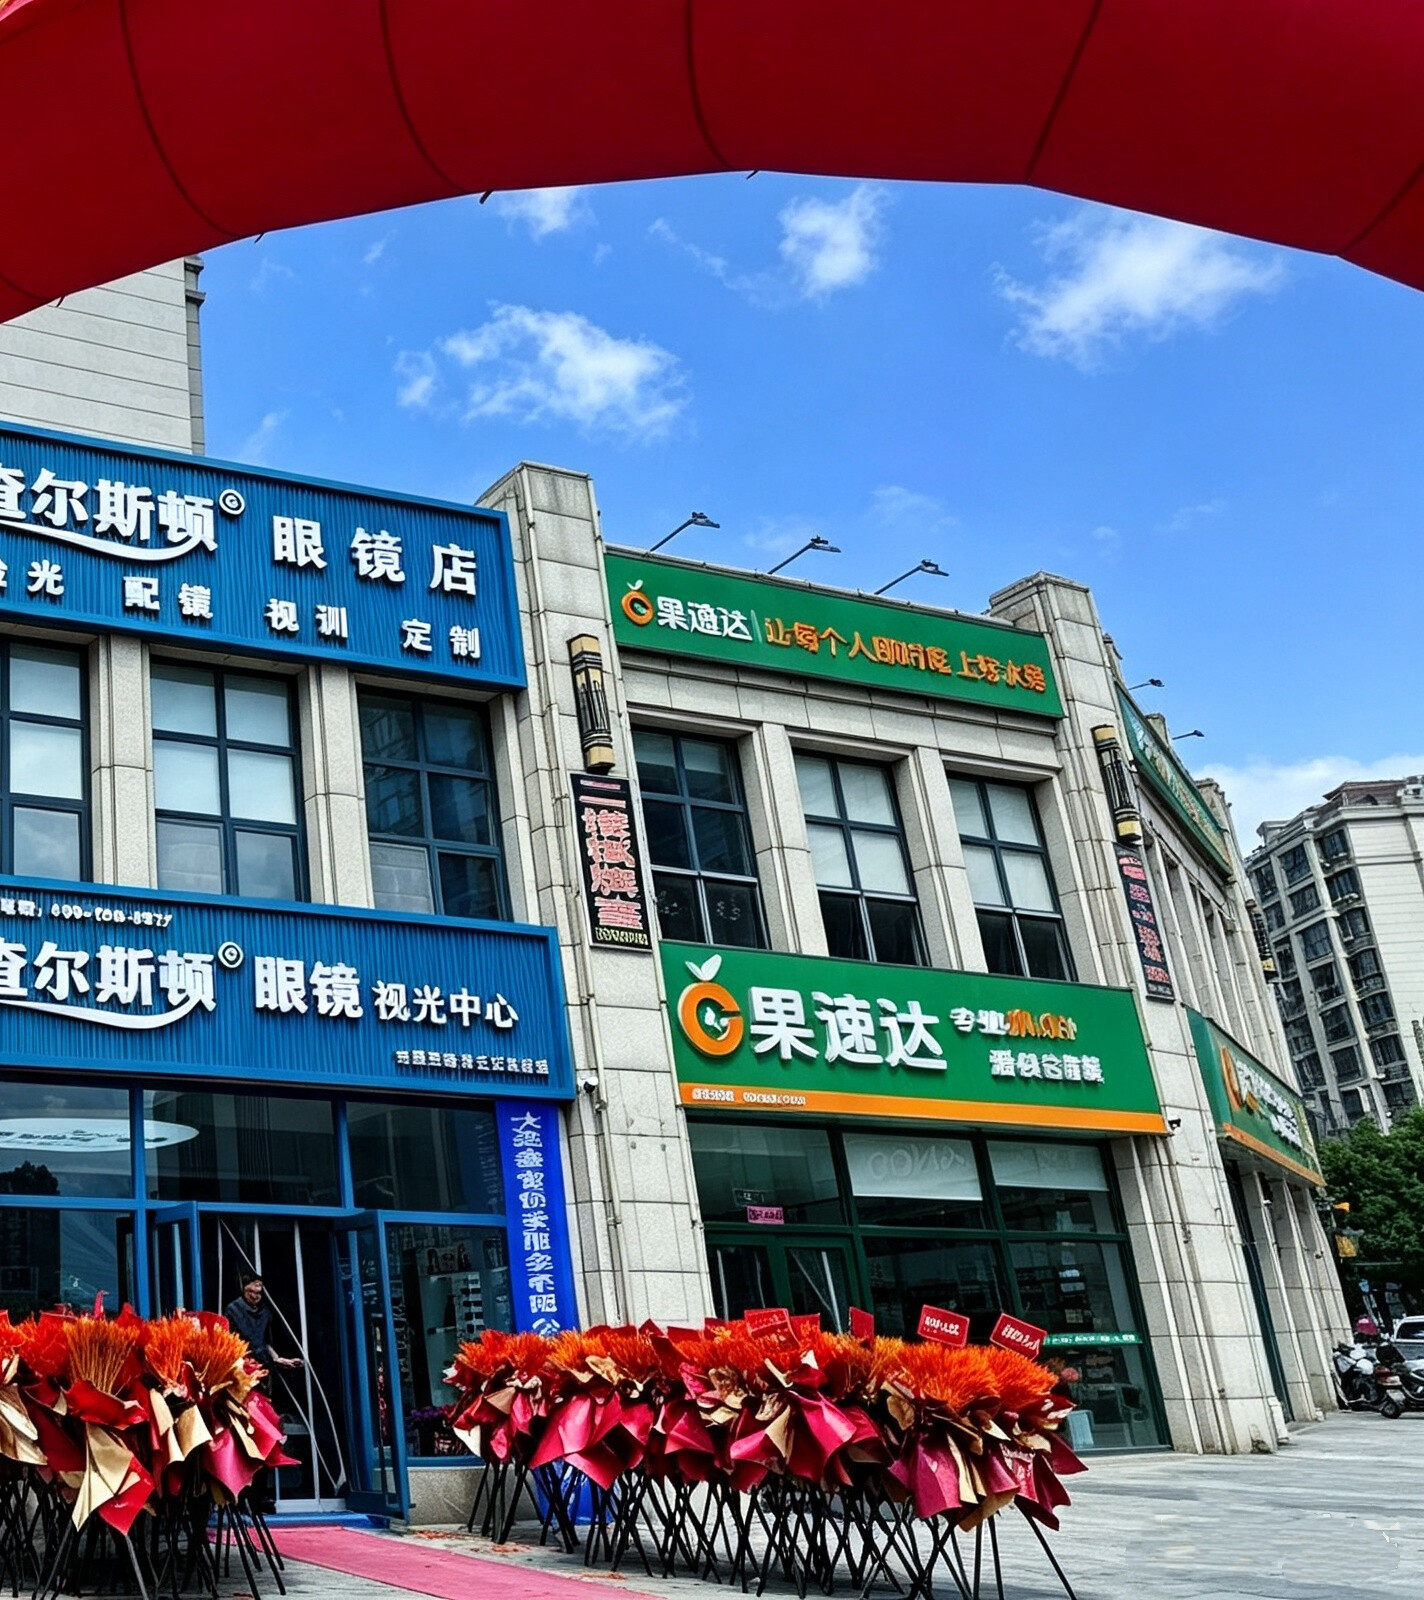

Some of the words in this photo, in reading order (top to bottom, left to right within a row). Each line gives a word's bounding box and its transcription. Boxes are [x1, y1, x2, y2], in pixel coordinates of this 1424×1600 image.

[272, 515, 479, 596] 眼镜店
[264, 597, 348, 640] 视训
[400, 618, 481, 660] 定制
[254, 957, 363, 1020] 眼镜
[371, 980, 519, 1028] 视光中心
[749, 985, 948, 1071] 果速达
